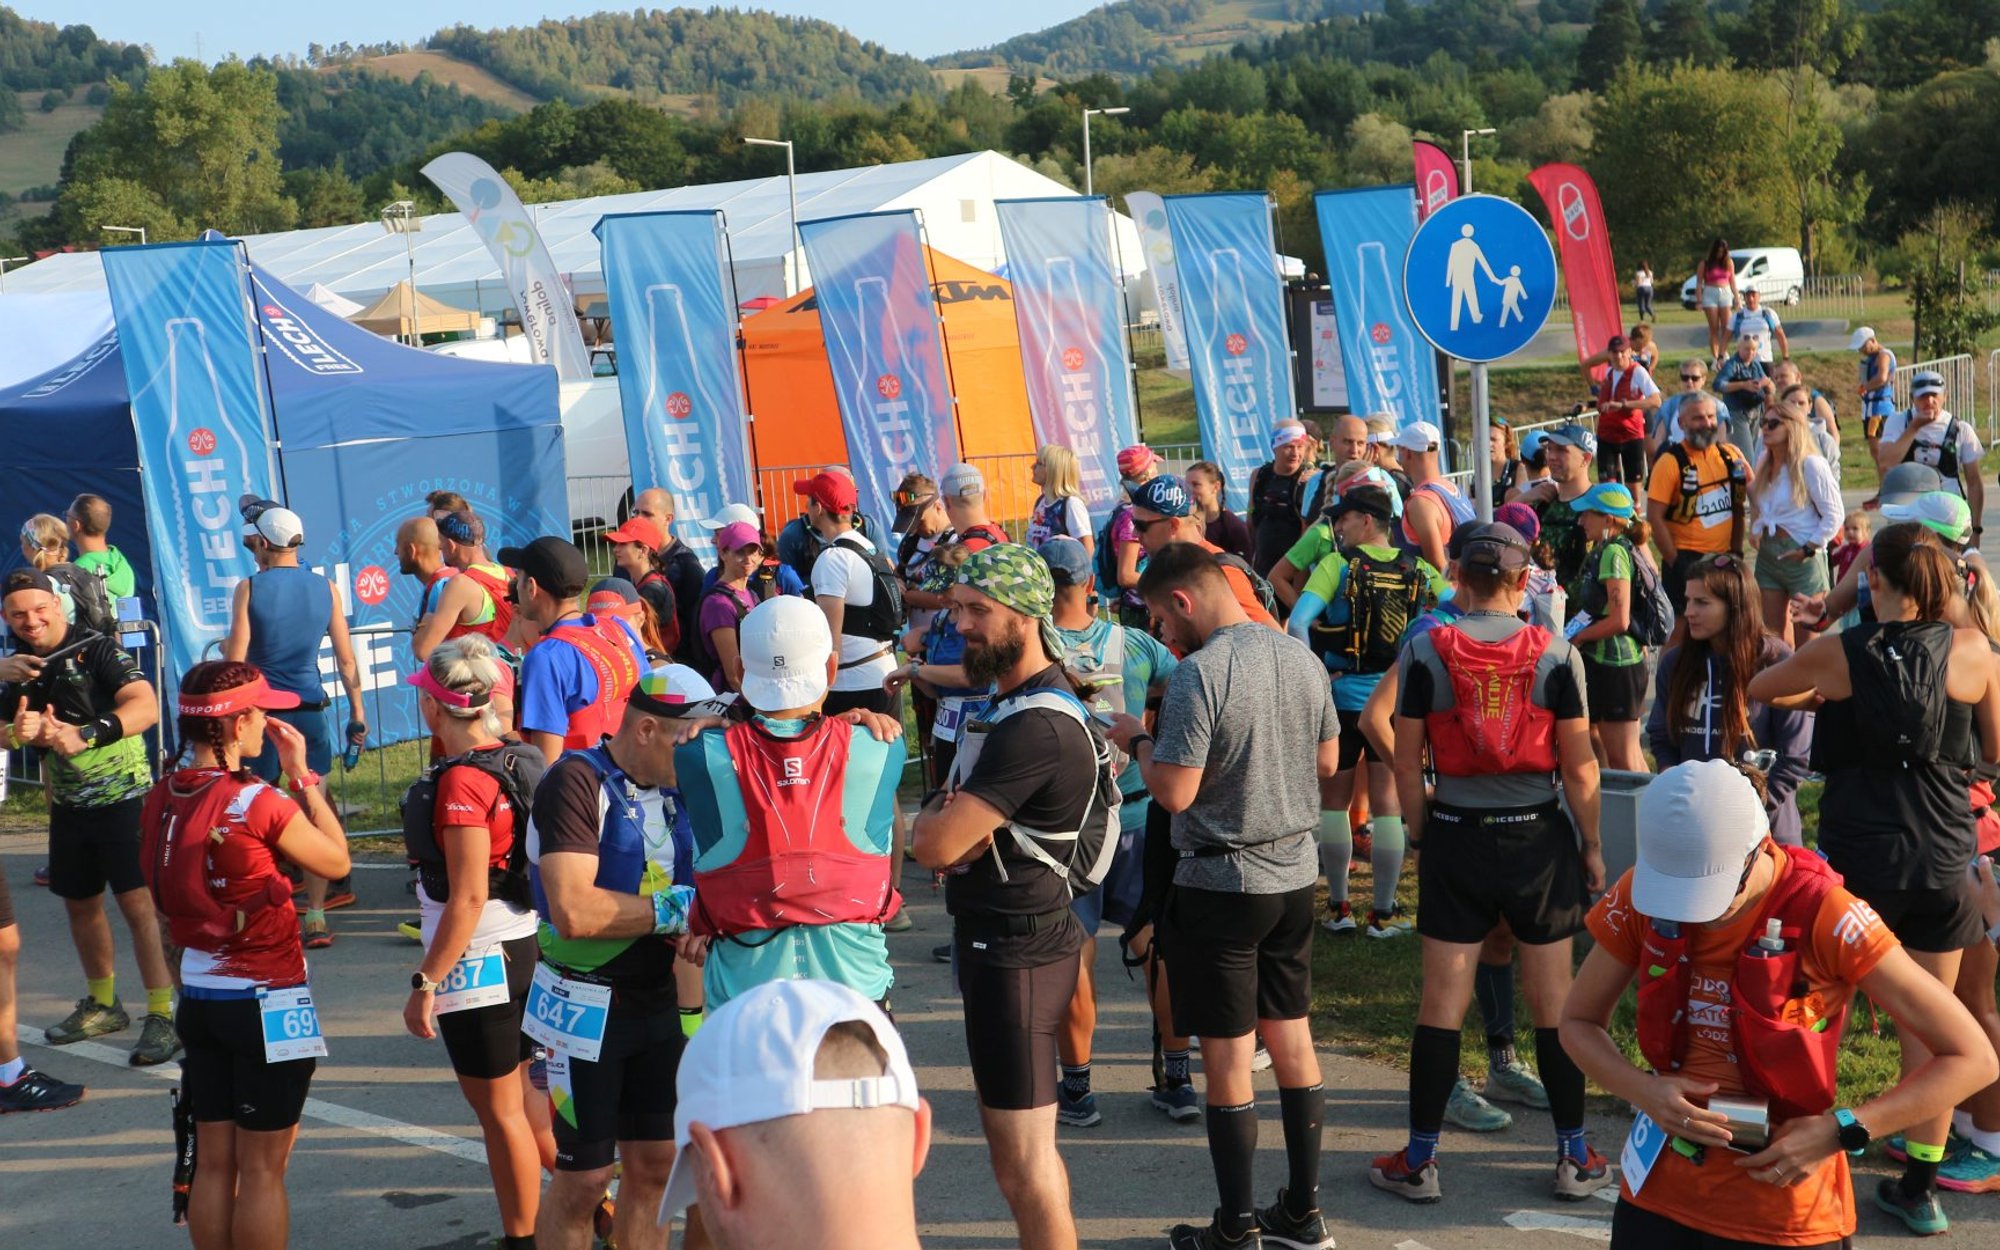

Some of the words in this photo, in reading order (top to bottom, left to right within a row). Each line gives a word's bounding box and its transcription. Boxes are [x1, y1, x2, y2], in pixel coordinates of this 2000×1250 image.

[268, 318, 338, 363] LECH
[376, 478, 496, 511] STWORZONA
[1153, 482, 1184, 507] Buff
[1702, 495, 1732, 517] 2100
[1495, 813, 1538, 823] ICEBUG
[537, 992, 586, 1033] 647
